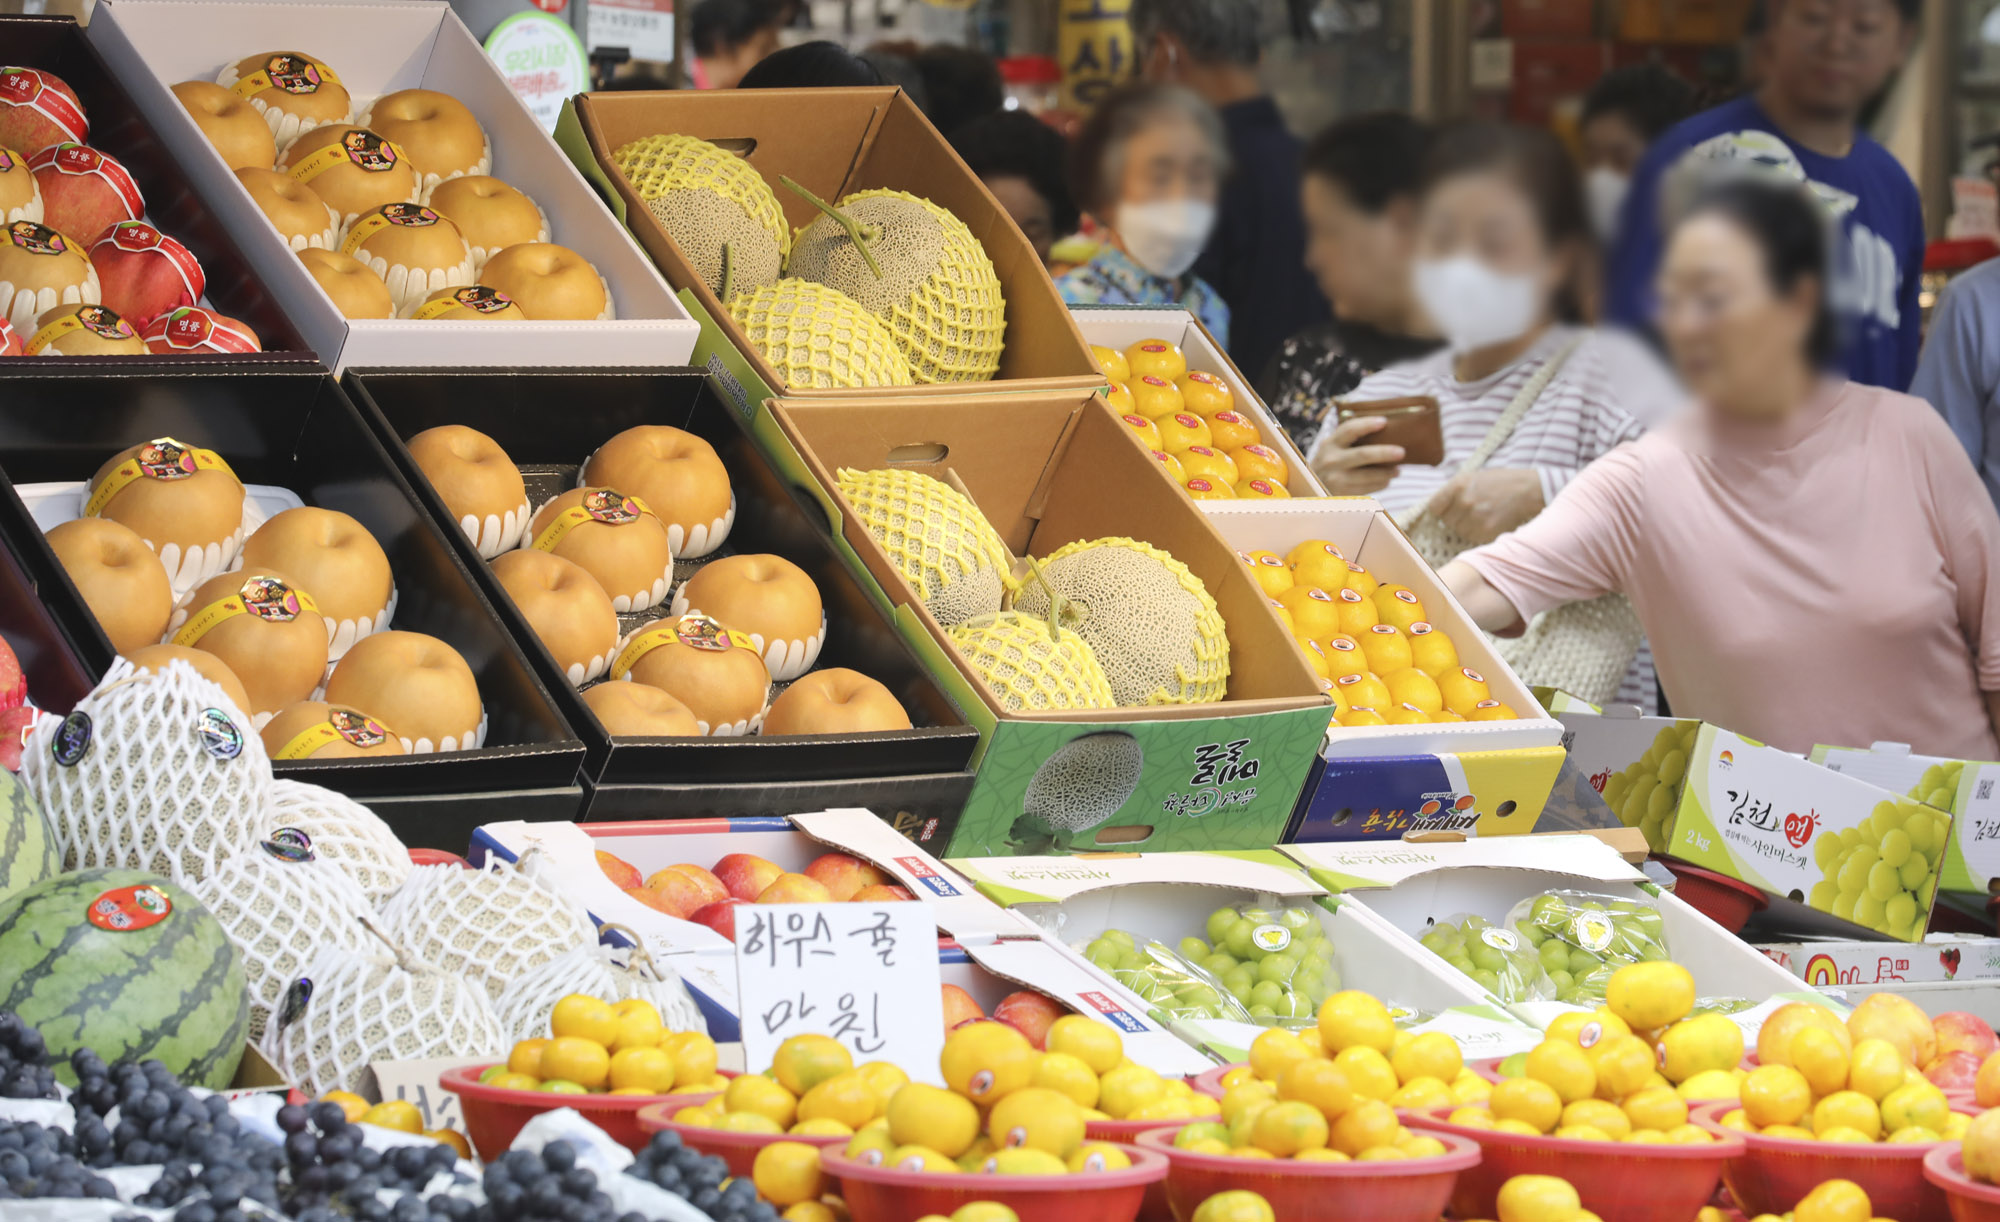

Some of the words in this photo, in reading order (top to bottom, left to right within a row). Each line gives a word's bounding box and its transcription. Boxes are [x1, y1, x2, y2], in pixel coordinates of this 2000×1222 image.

[10, 75, 30, 91] 명품
[69, 150, 90, 162] 명품
[128, 228, 149, 240] 명품
[179, 320, 200, 332] 명품
[1190, 738, 1260, 786] 멜론
[1726, 789, 1772, 825] 김천
[1361, 807, 1409, 834] 감귤
[1686, 829, 1695, 843] 2
[1695, 834, 1712, 853] kg
[743, 911, 836, 968] 하우스
[848, 912, 897, 967] 귤
